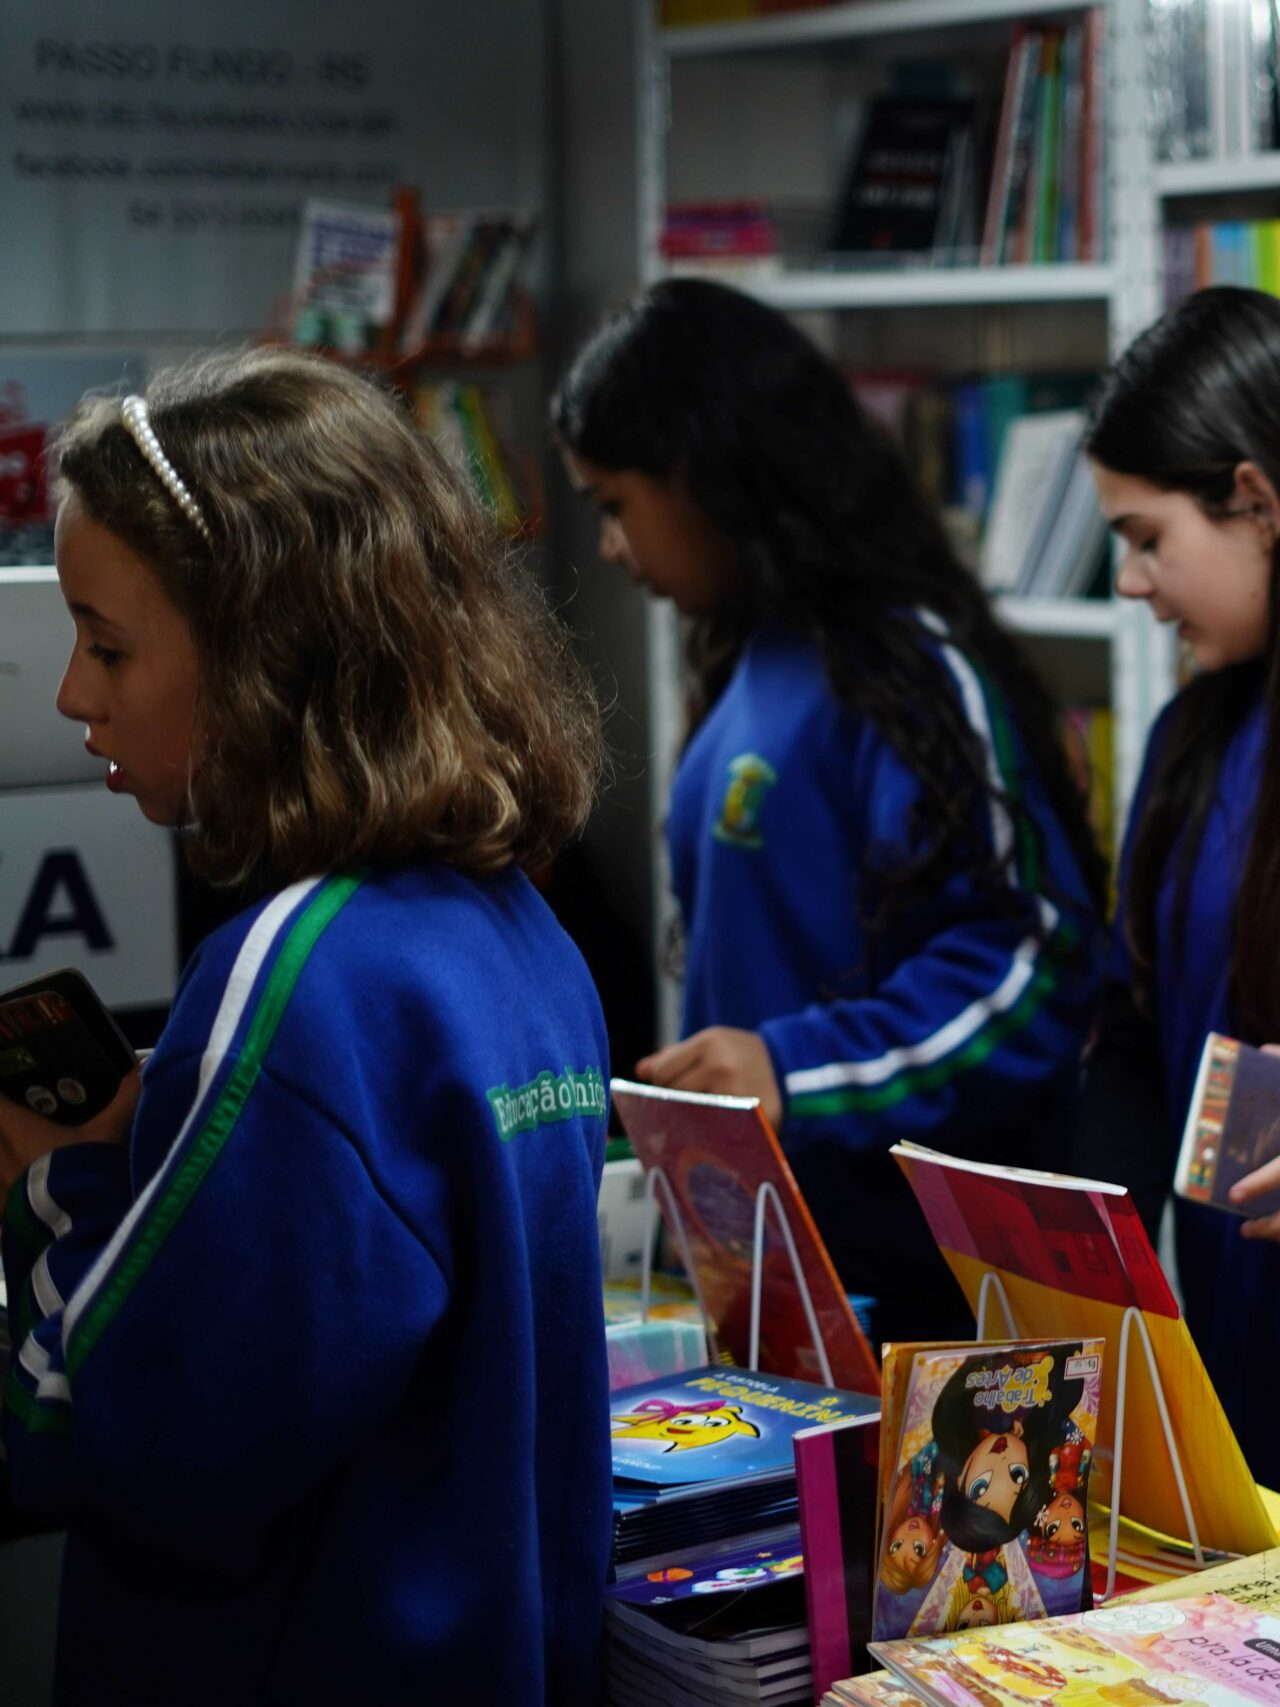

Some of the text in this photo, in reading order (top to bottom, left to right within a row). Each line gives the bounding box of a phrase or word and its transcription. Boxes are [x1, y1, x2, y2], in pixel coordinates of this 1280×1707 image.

[34, 37, 160, 81] PASSO
[166, 43, 295, 88] FUNDO
[317, 49, 373, 93] RS
[0, 847, 114, 960] A
[494, 1078, 572, 1133] Educação
[966, 1366, 1033, 1388] de Artes
[974, 1389, 1037, 1409] Trabalho
[1170, 1636, 1230, 1656] pra
[1220, 1653, 1259, 1669] lá
[1178, 1650, 1234, 1679] GABITO
